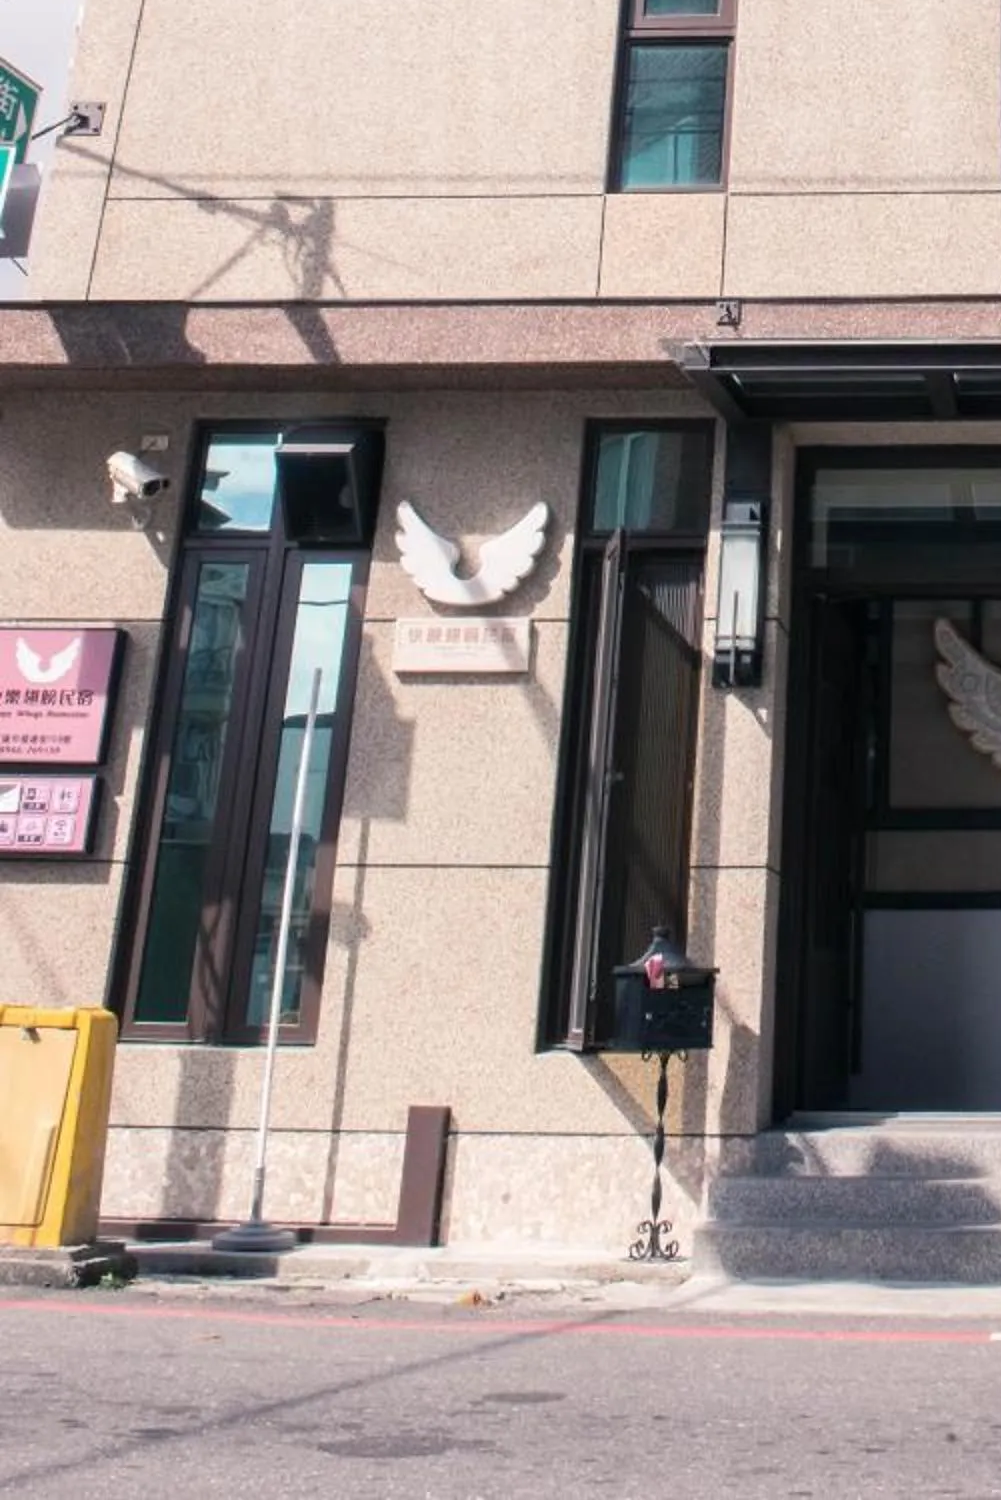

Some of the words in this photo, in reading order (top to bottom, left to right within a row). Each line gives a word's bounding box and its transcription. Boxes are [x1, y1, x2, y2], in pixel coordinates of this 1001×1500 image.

[0, 689, 94, 707] 樂翅膀民宿
